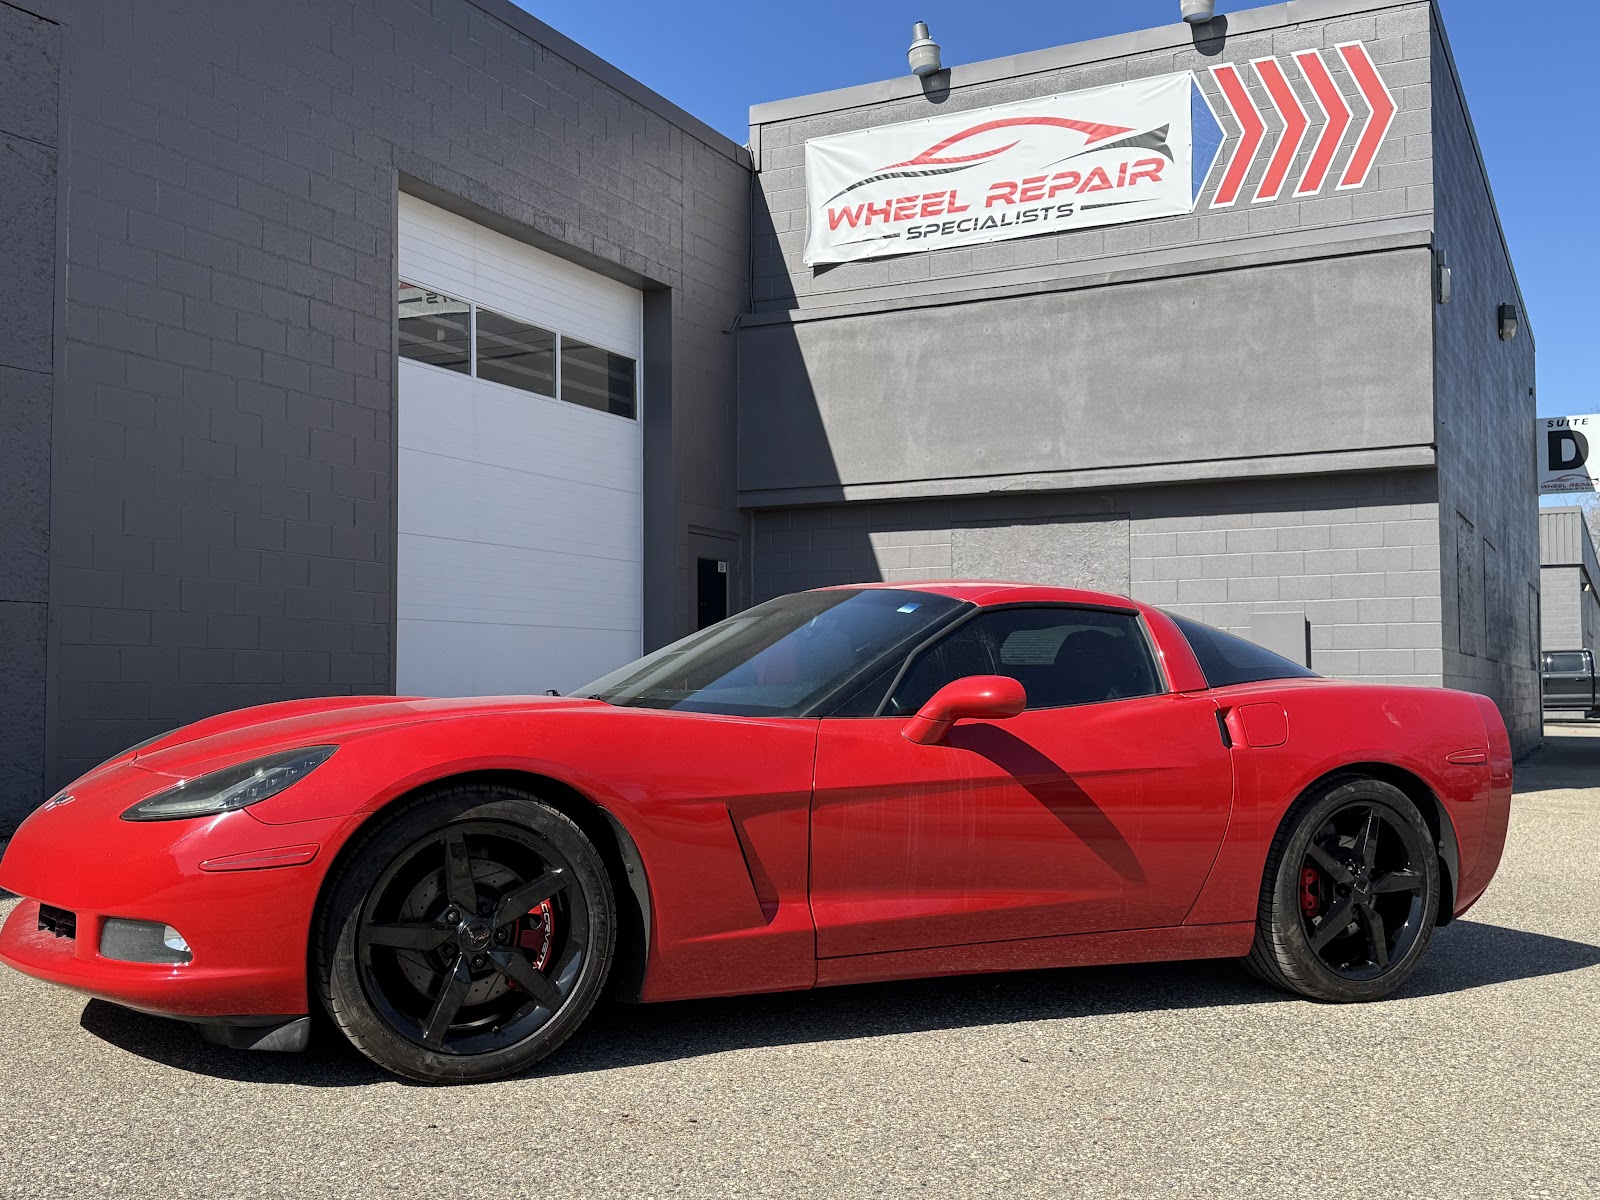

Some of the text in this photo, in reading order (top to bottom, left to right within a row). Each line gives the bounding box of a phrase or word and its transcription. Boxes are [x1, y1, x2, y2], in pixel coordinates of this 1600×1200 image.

[828, 157, 1165, 231] WHEEL REPAIR
[906, 202, 1075, 240] SPECIALISTS
[1547, 418, 1589, 428] SUITE
[1548, 430, 1589, 471] D
